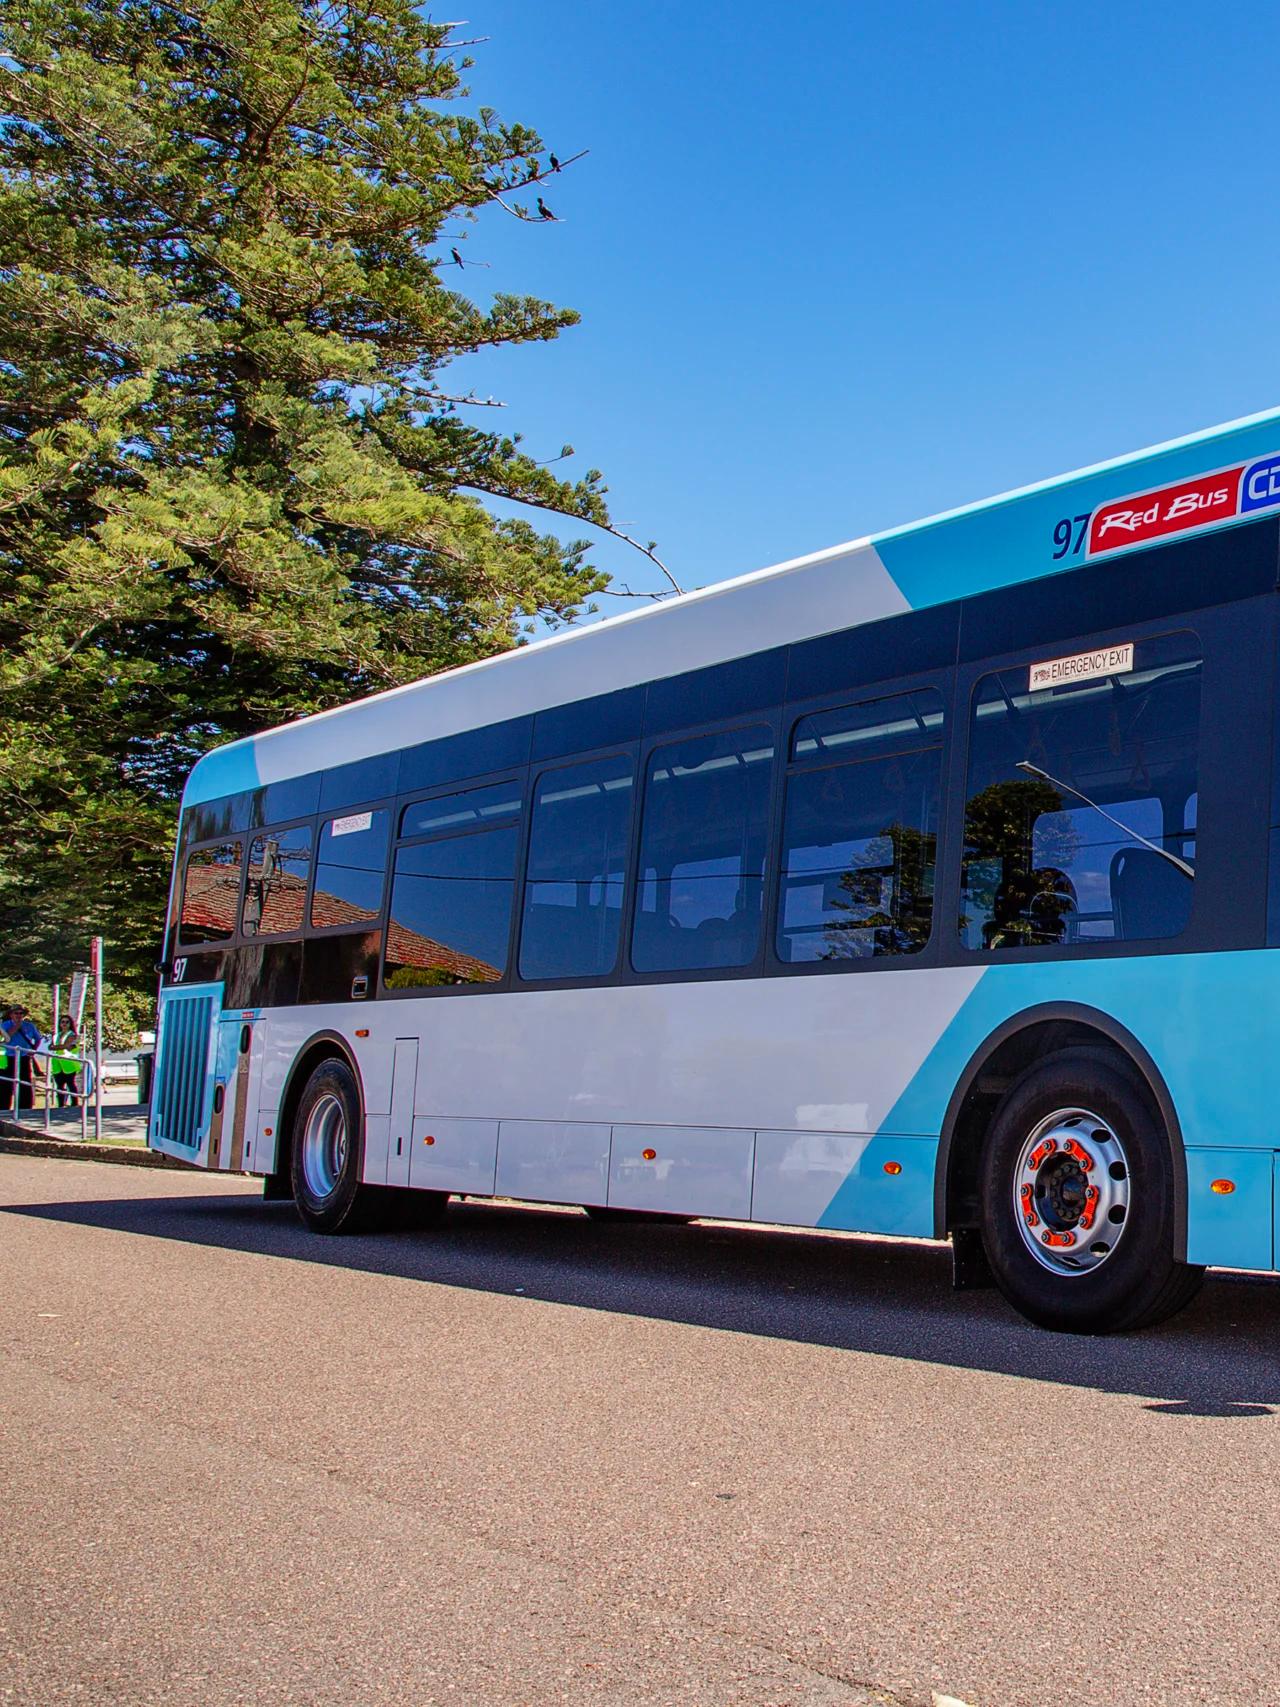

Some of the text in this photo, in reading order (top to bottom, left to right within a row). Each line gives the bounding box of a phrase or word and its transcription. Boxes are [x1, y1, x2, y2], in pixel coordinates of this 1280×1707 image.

[1053, 513, 1091, 560] 97
[1098, 503, 1159, 537] Red
[1163, 488, 1229, 522] Bus
[1051, 653, 1108, 679] EMERGENCY
[1109, 648, 1130, 666] EXIT
[173, 958, 187, 982] 97
